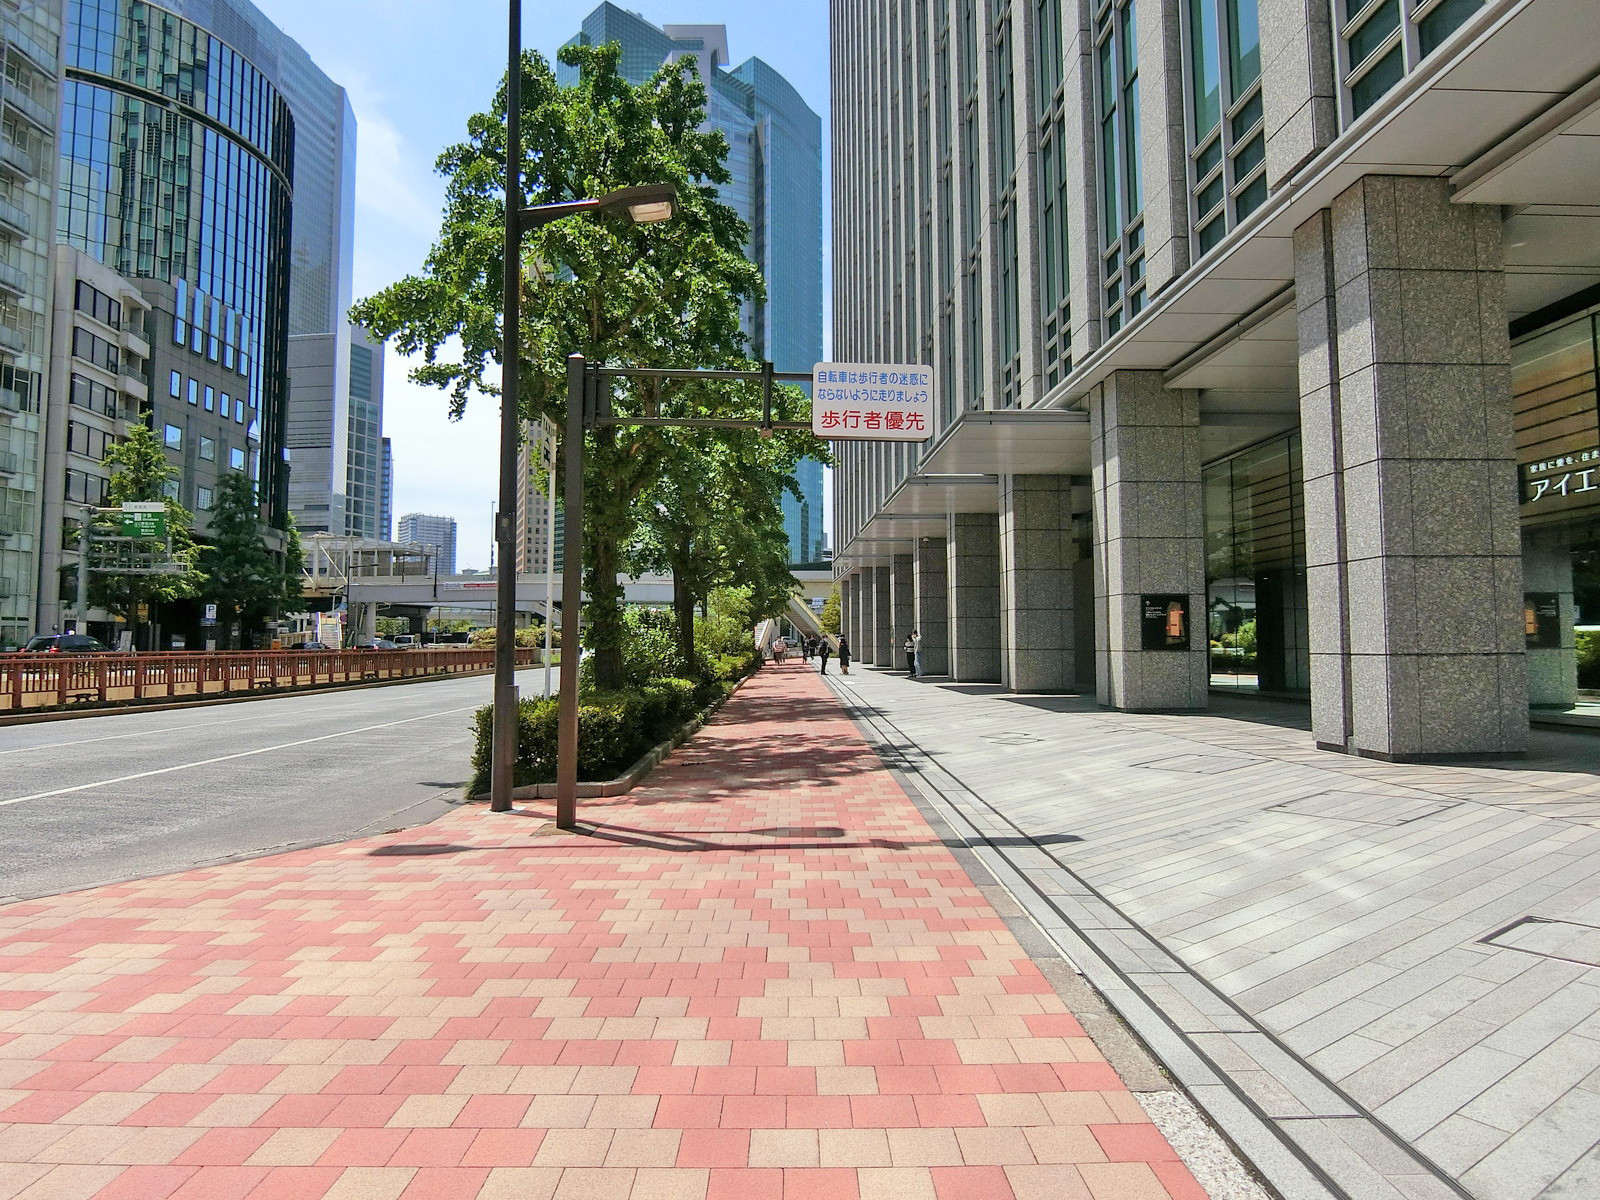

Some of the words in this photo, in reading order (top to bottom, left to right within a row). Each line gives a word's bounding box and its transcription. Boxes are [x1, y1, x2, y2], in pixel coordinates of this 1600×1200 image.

[818, 370, 928, 386] 自転車は歩行者の迷惑に
[817, 387, 928, 403] ならないように走りましょう
[821, 409, 925, 431] 歩行者優先
[1530, 468, 1600, 502] アイエ
